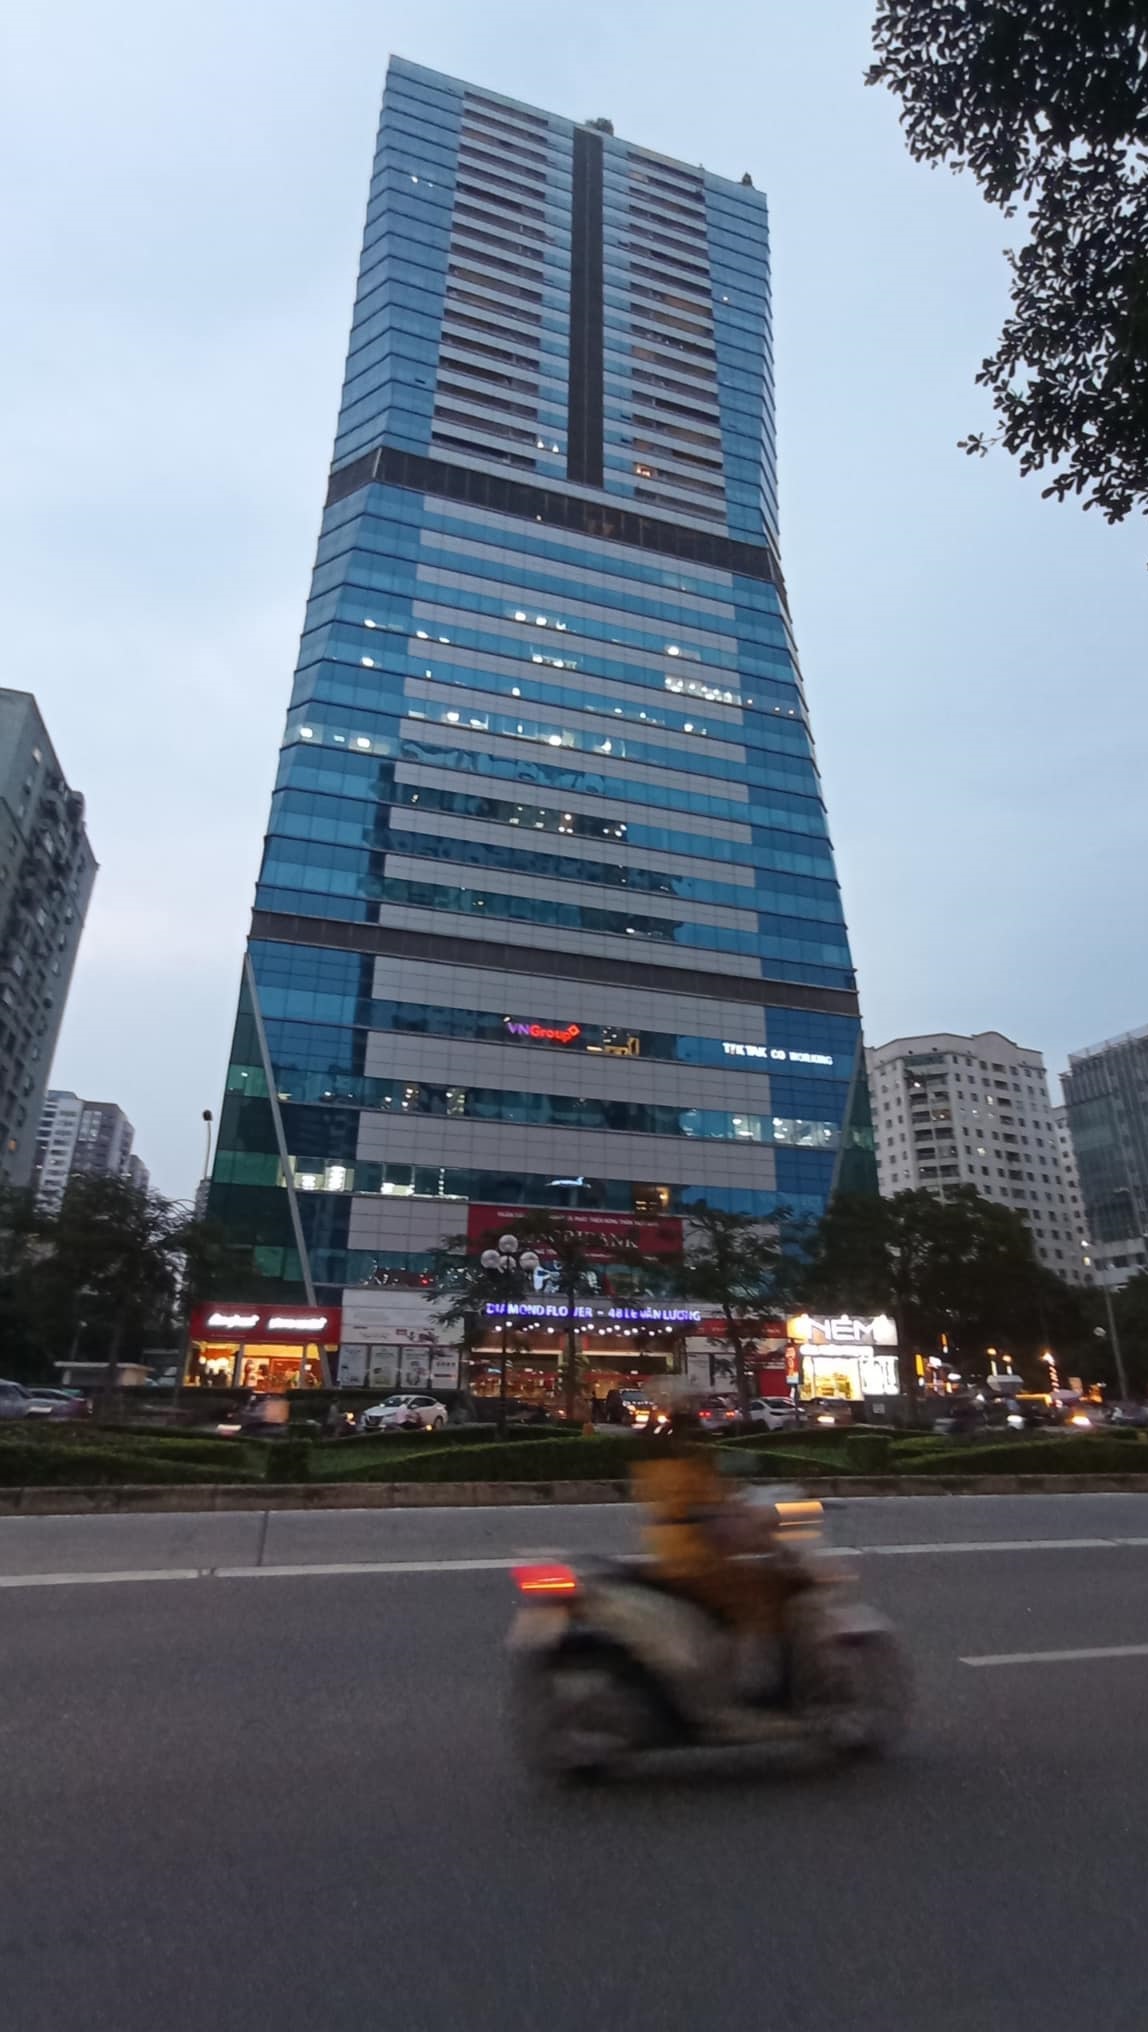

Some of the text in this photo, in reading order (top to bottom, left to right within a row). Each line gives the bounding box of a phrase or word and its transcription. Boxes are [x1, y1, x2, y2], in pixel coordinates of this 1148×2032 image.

[507, 1022, 572, 1043] VNGroup
[546, 1305, 593, 1317] FLOER
[608, 1307, 623, 1319] 48
